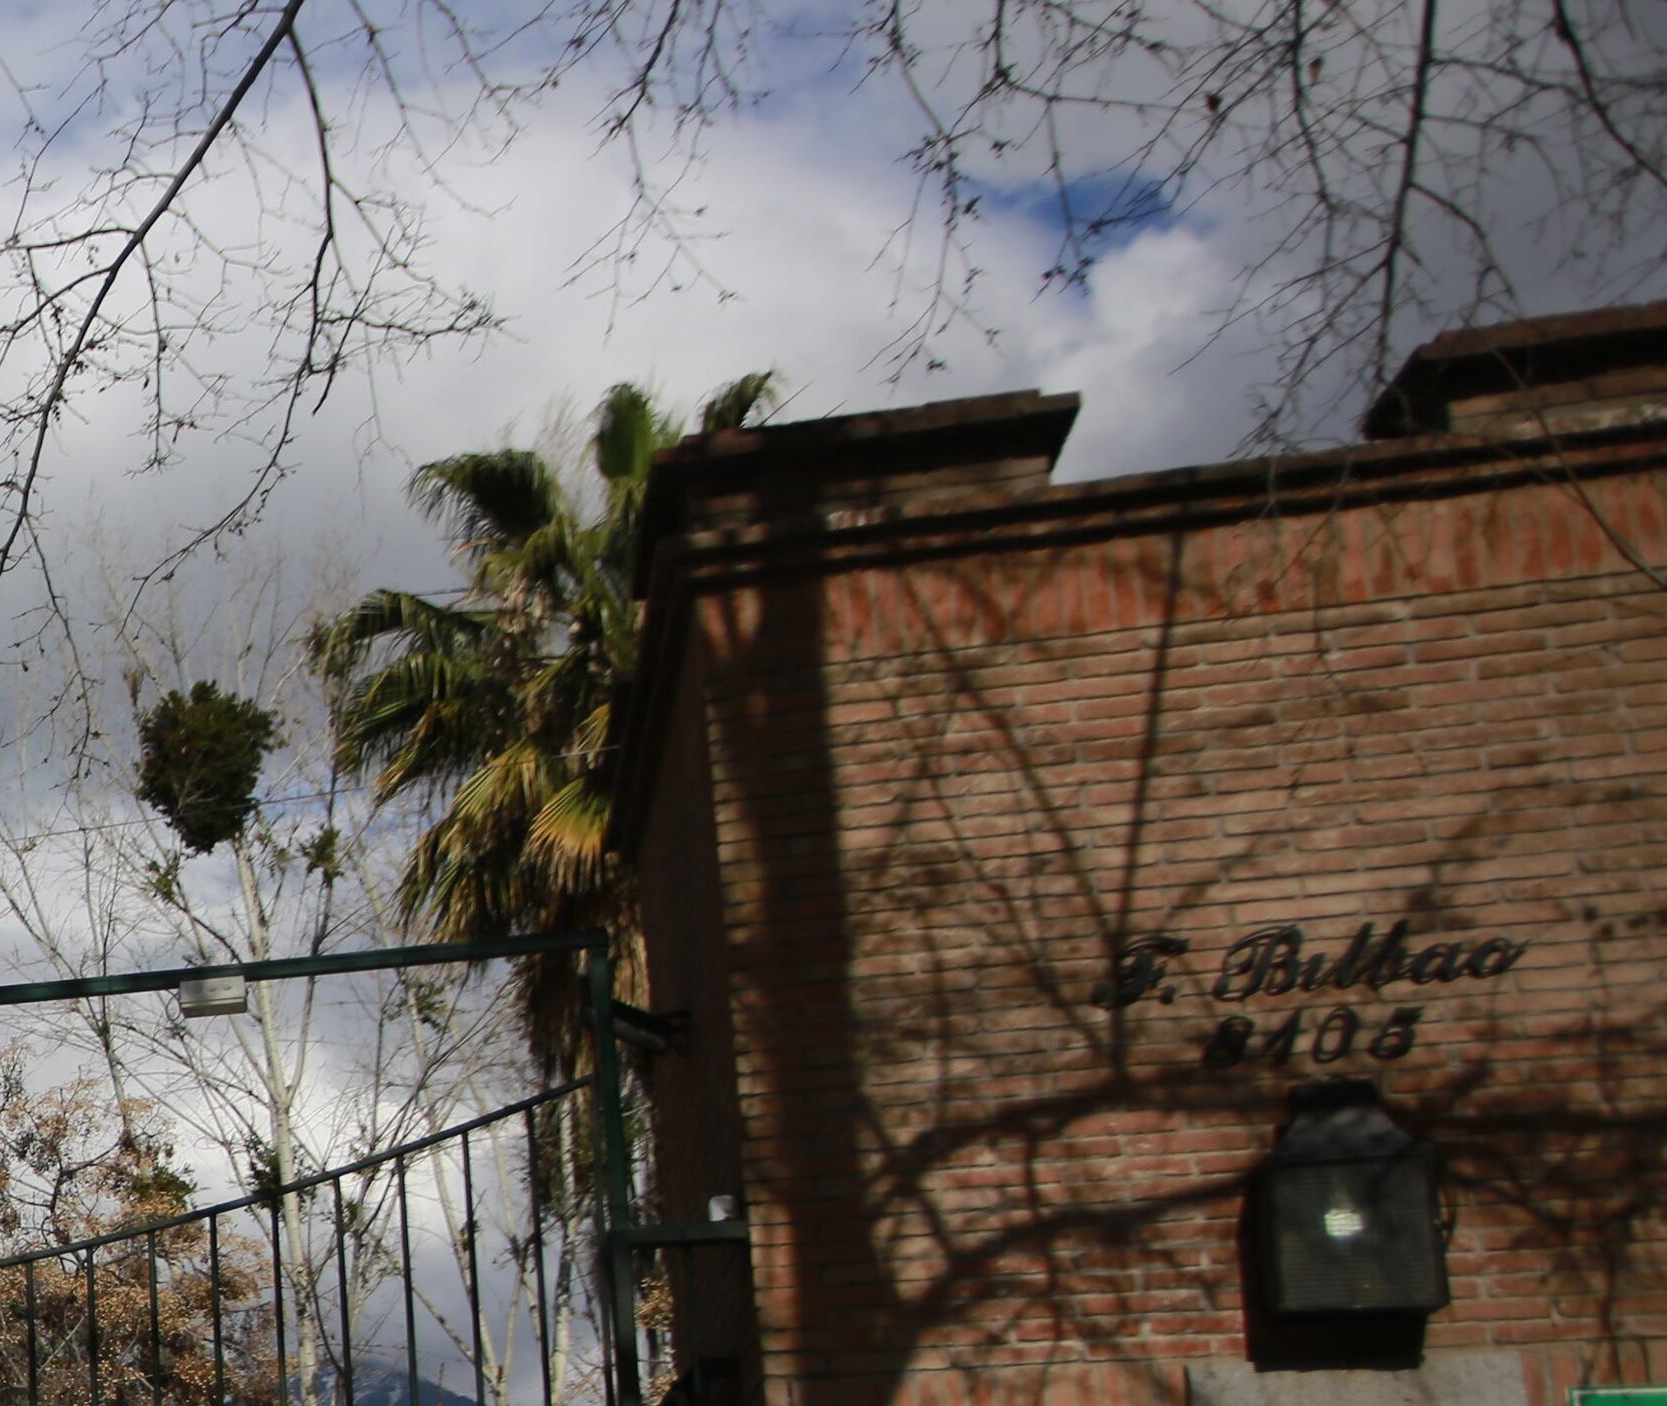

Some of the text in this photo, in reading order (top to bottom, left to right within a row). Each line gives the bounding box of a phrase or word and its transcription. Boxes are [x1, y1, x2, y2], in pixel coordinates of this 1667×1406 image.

[1095, 918, 1531, 1008] F. Bilbao
[1203, 1004, 1425, 1068] 8105
